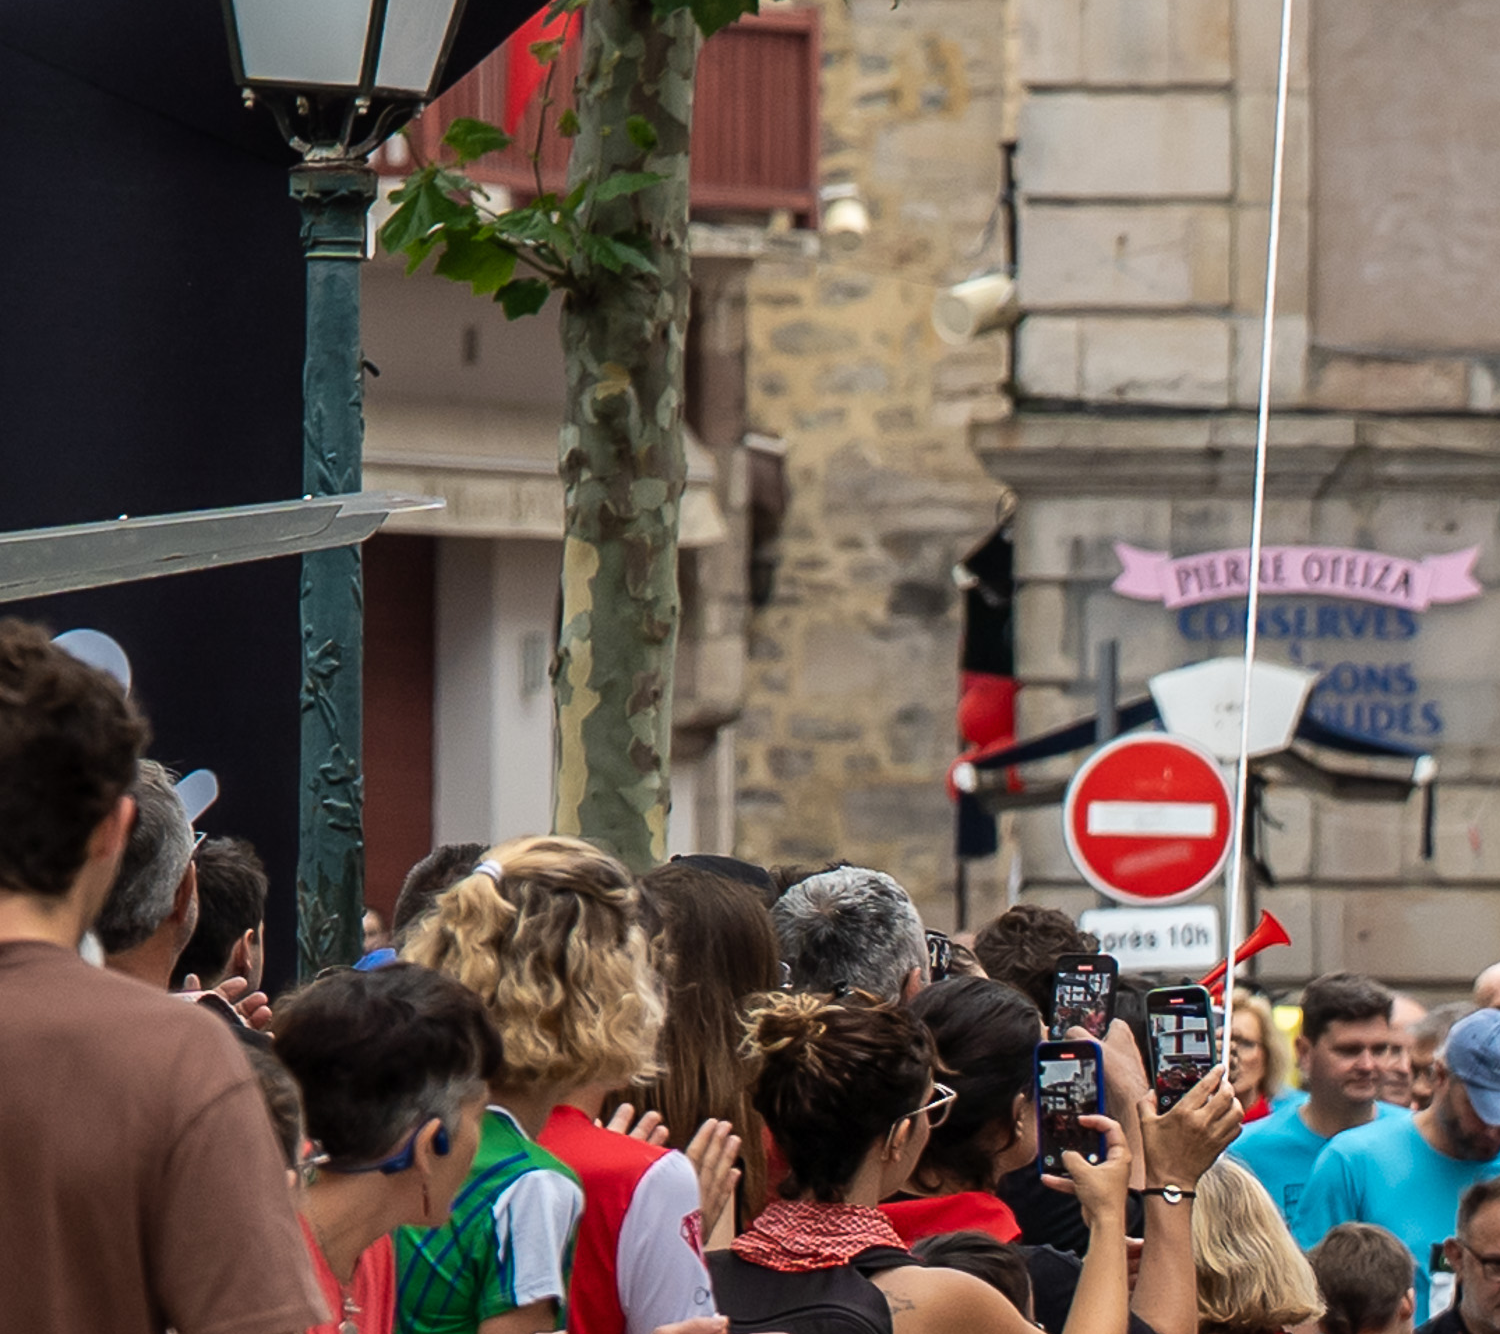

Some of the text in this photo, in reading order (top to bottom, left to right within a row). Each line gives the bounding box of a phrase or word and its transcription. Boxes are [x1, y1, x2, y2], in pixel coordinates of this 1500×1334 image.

[1174, 552, 1411, 597] PIERRE OTEIZA
[1177, 603, 1419, 640] CONSERVES
[1169, 923, 1209, 947] 10h
